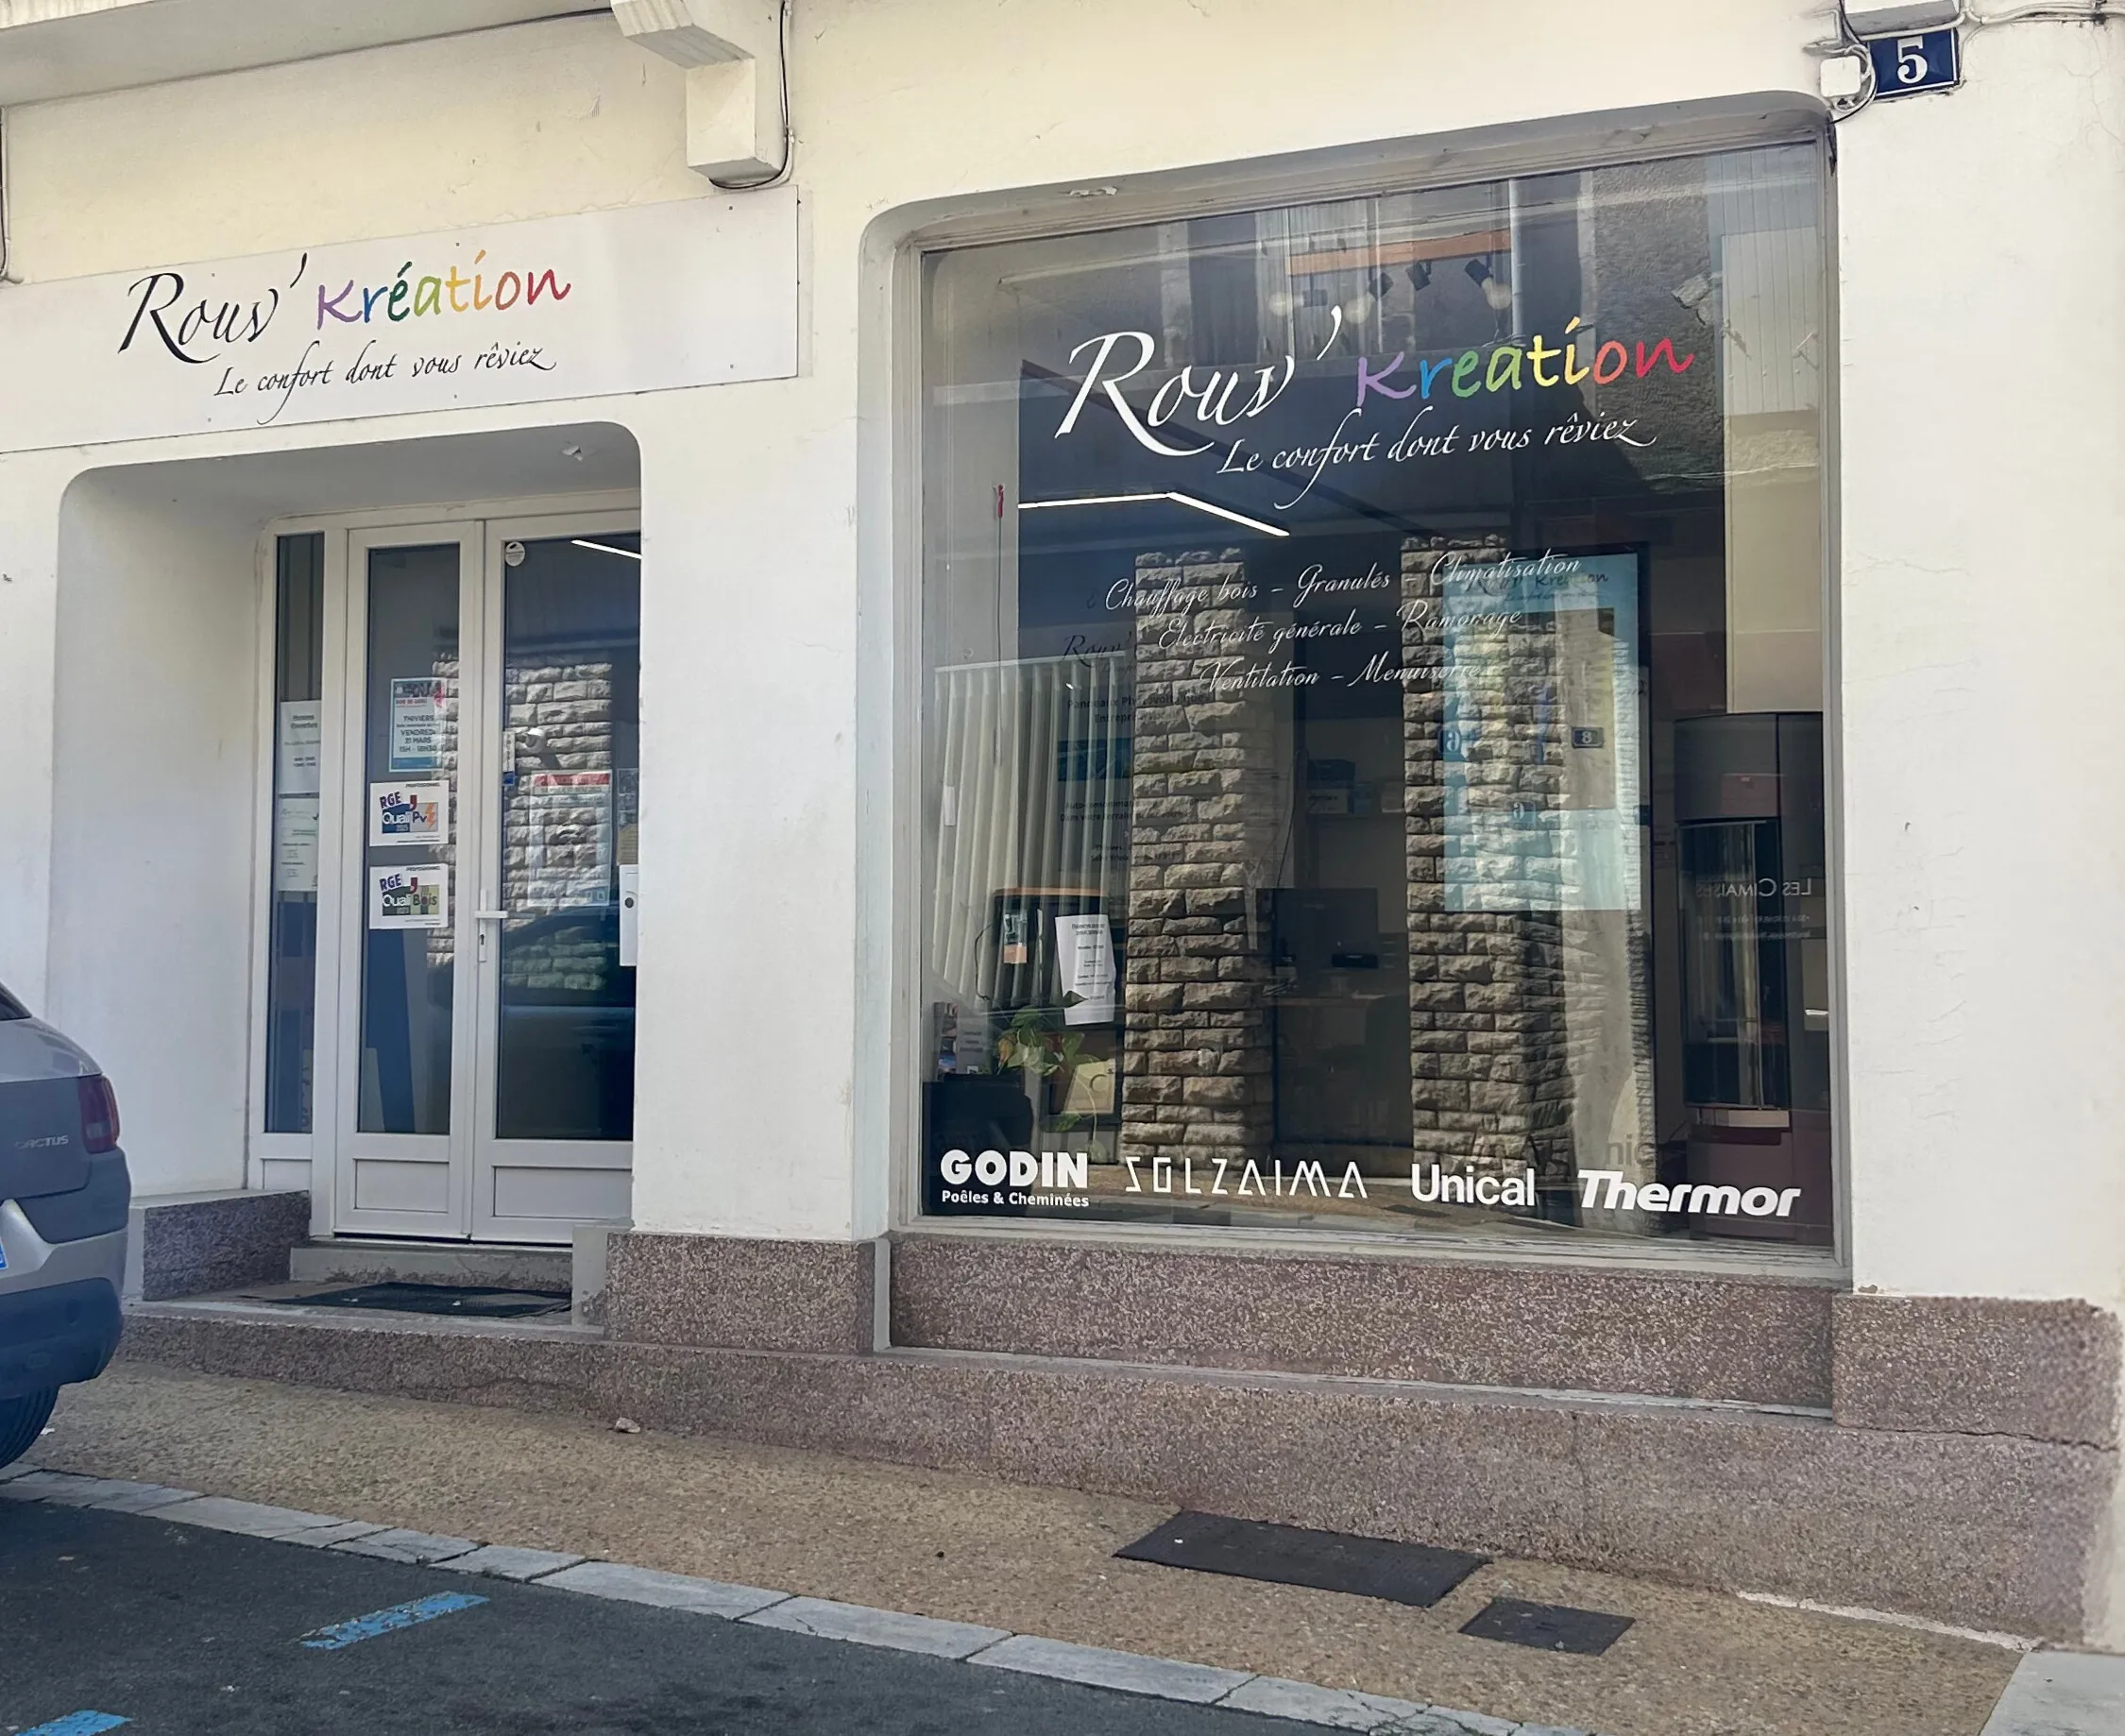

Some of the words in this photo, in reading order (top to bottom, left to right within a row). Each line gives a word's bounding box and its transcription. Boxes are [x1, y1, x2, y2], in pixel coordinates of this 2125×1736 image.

[1896, 35, 1929, 85] 5
[316, 249, 571, 331] Kréation
[213, 366, 248, 397] Le
[256, 340, 334, 426] confort
[345, 339, 398, 384] dont
[412, 354, 462, 378] vous
[474, 341, 556, 371] rêviez
[1357, 316, 1695, 407] Kreation
[1216, 437, 1263, 474] Le
[1273, 407, 1381, 510] confort
[1387, 405, 1461, 464] dont
[1469, 427, 1532, 451] vous
[1544, 410, 1658, 448] rêviez
[1105, 575, 1209, 617] Chauffage
[1216, 574, 1258, 602] bois
[1292, 563, 1390, 608] Granulés
[1429, 548, 1582, 587] Climatisation
[1158, 615, 1275, 650] Electricité
[1267, 607, 1363, 655] générale
[1199, 655, 1321, 692] Ventilation
[379, 791, 401, 809] RGE
[379, 873, 402, 892] RGE
[940, 1149, 1089, 1188] GODIN
[1124, 1156, 1368, 1200] SOLZAIMA
[1411, 1163, 1537, 1207] Unical
[1577, 1168, 1802, 1217] Thermor
[941, 1189, 990, 1204] Poêles
[993, 1191, 1005, 1205] &
[1008, 1191, 1090, 1208] Cheminées
